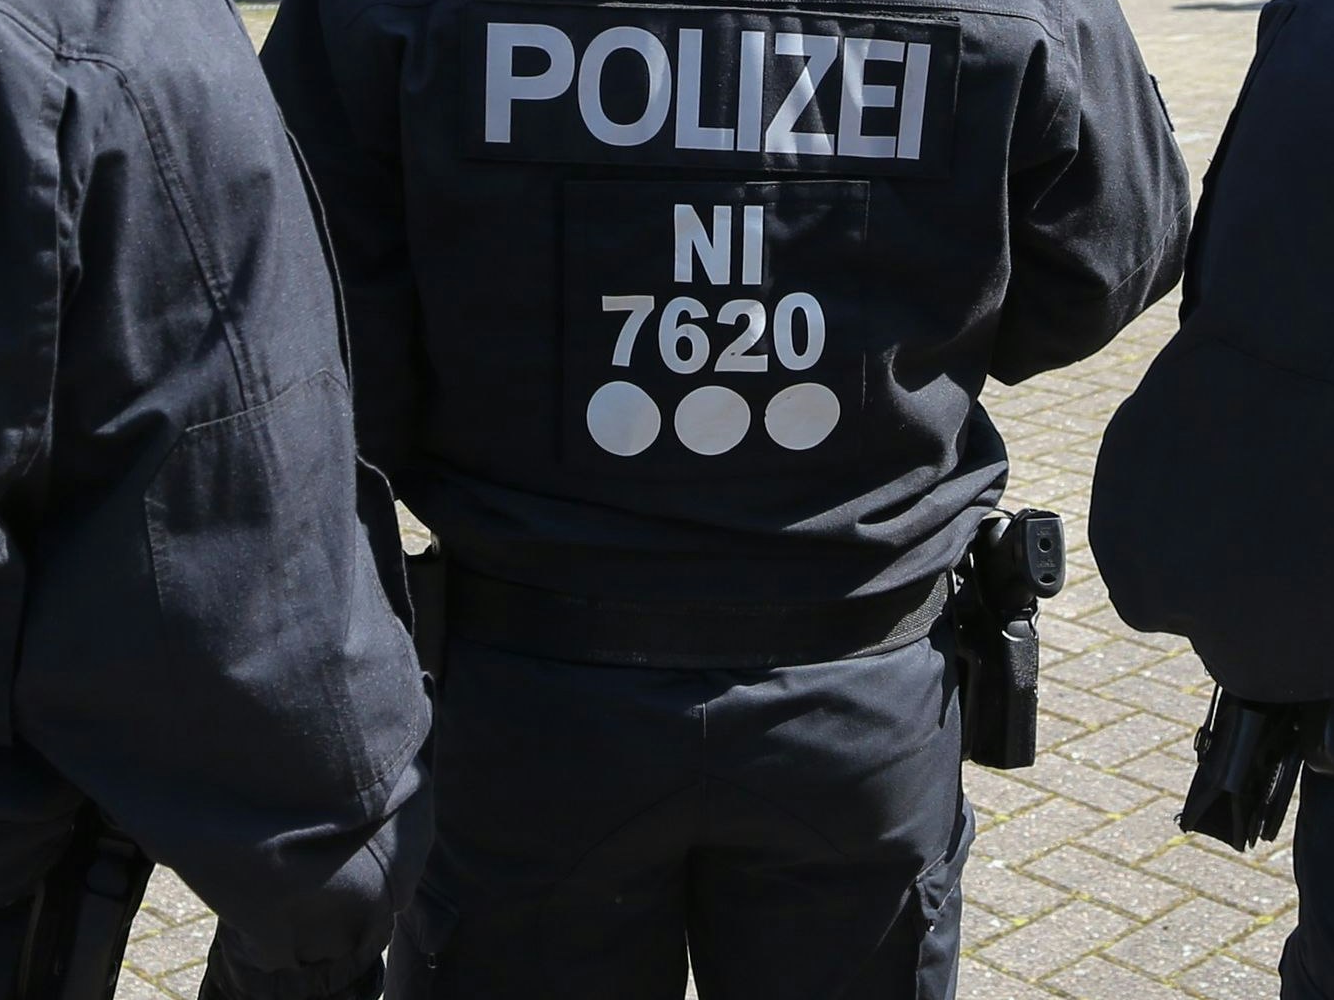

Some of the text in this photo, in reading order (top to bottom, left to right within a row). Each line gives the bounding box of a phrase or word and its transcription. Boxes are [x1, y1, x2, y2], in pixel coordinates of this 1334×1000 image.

[485, 22, 931, 160] POLIZEI
[673, 203, 764, 285] NI
[601, 292, 826, 375] 7620
